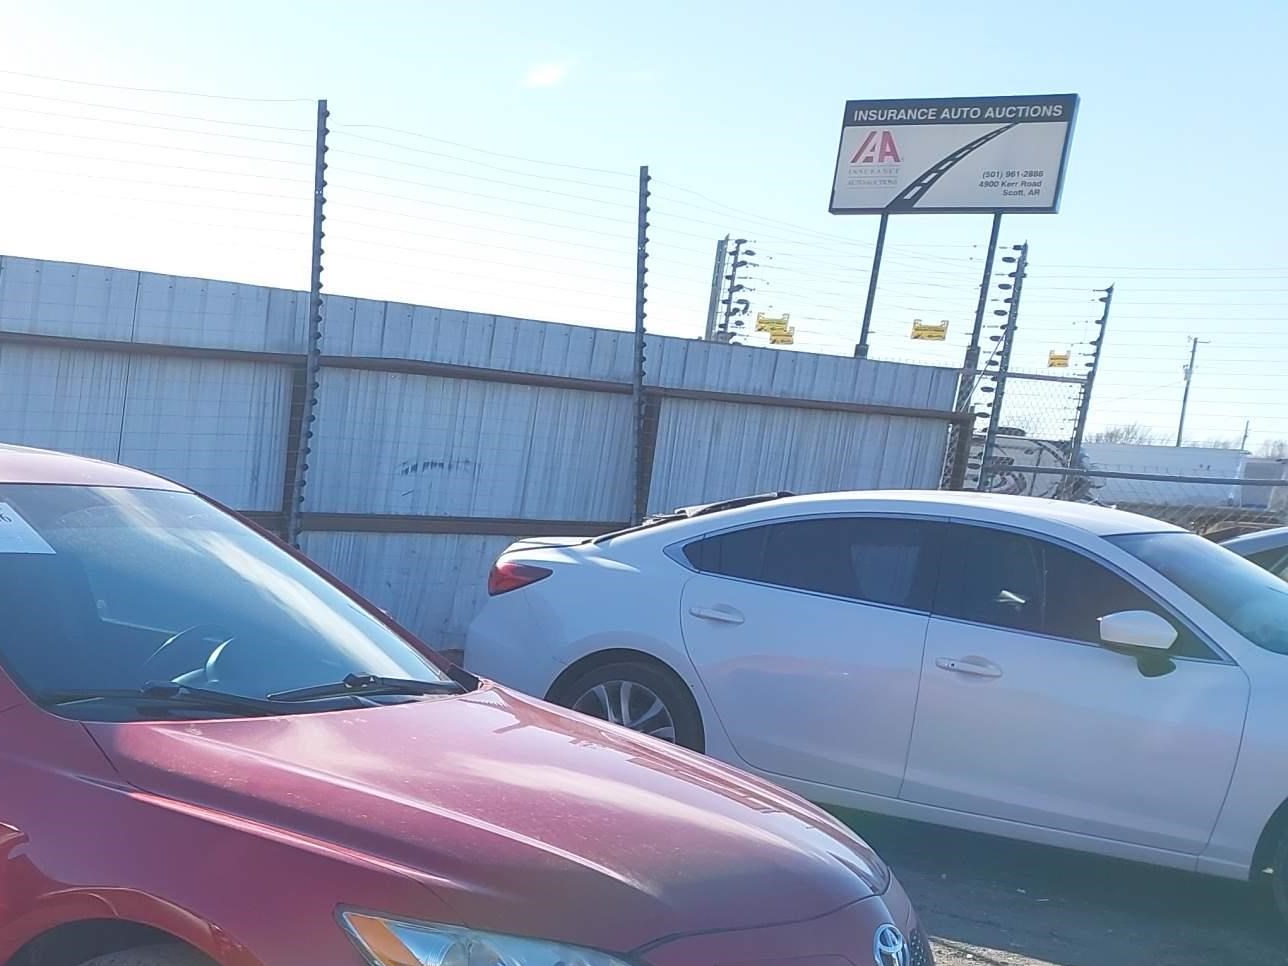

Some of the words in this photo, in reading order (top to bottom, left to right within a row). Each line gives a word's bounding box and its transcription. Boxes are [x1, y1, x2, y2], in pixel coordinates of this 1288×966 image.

[854, 108, 938, 121] INSURANCE
[940, 107, 981, 119] AUTO
[984, 105, 1063, 118] AUCTIONS
